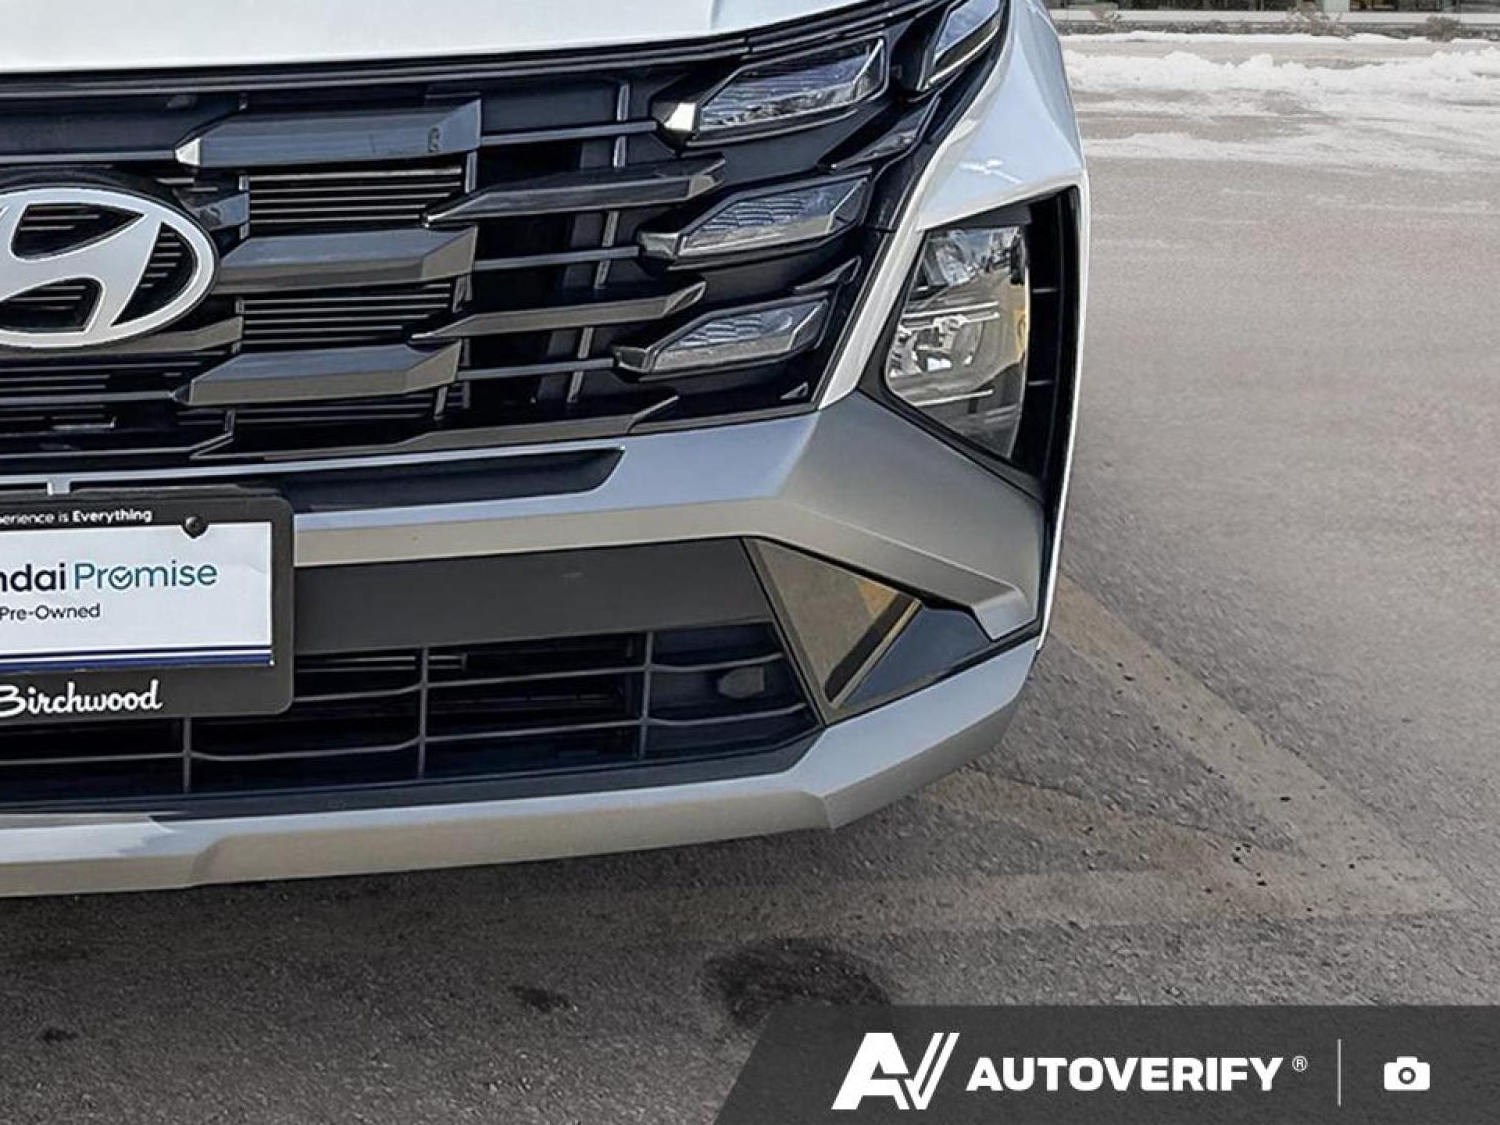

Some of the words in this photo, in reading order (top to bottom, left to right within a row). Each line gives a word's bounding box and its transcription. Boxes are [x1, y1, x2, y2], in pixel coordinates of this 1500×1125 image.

[58, 511, 69, 523] is
[72, 507, 153, 524] Everything
[74, 559, 219, 590] Promise
[0, 603, 101, 622] Pre-Owned
